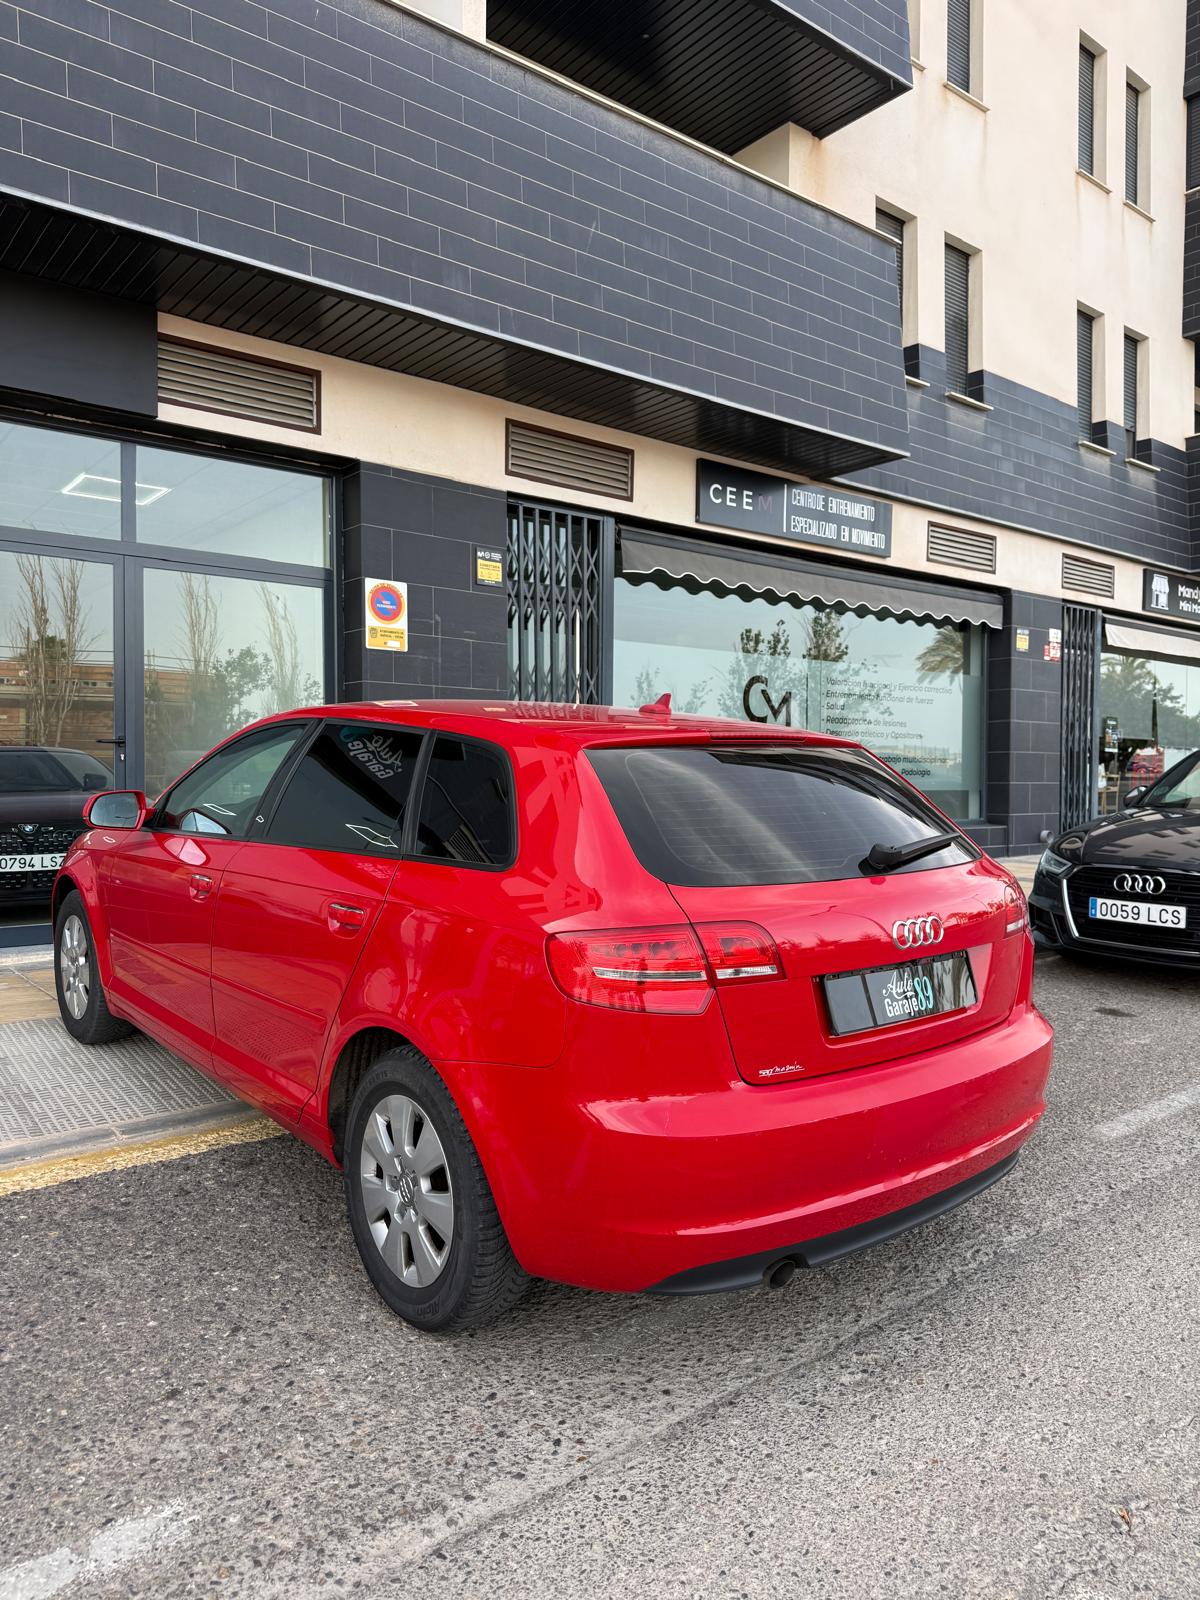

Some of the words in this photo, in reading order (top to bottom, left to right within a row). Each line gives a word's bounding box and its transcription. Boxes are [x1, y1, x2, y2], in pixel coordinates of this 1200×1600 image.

[792, 489, 816, 510] CENTRO
[816, 494, 826, 511] DE
[828, 497, 875, 522] ENTRENAMIENTO
[791, 515, 837, 540] ESPECIALIZADO
[841, 525, 849, 543] EN
[851, 527, 886, 549] MOVIMIENTO
[1179, 600, 1192, 612] Mini
[825, 689, 875, 701] Entrenamiento
[825, 701, 845, 711] Salud
[0, 857, 36, 870] 0794
[1100, 902, 1140, 921] 0059
[1147, 906, 1181, 926] LCS
[883, 971, 915, 999] Auto
[914, 976, 933, 1010] 89
[884, 998, 919, 1018] Garaje
